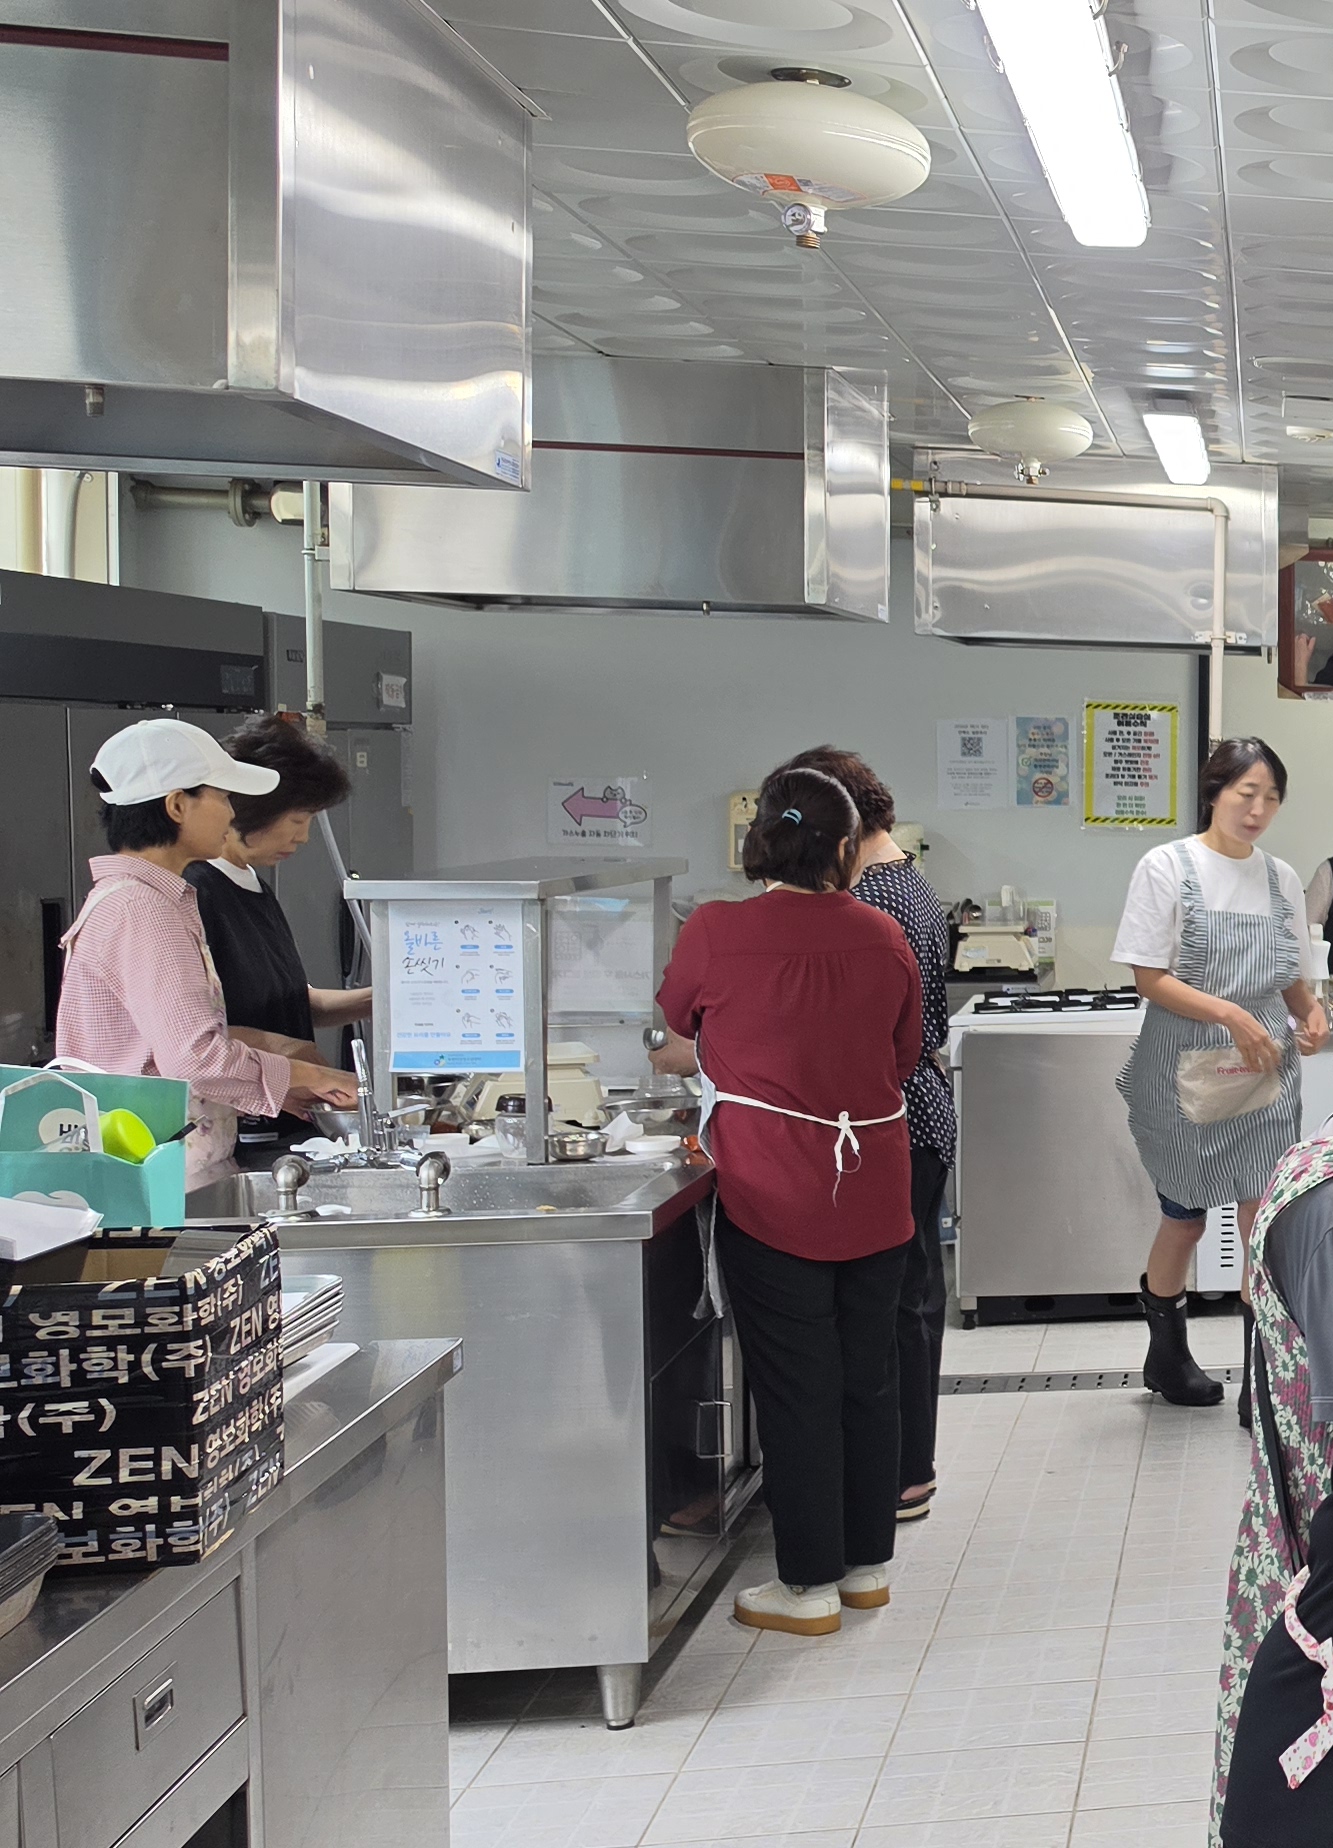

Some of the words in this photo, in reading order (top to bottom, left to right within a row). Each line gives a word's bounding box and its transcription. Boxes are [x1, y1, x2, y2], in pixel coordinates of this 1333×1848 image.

[404, 930, 443, 956] 올바른
[402, 957, 445, 977] 손씻기
[229, 1303, 263, 1355] ZEN
[72, 1443, 199, 1487] ZEN
